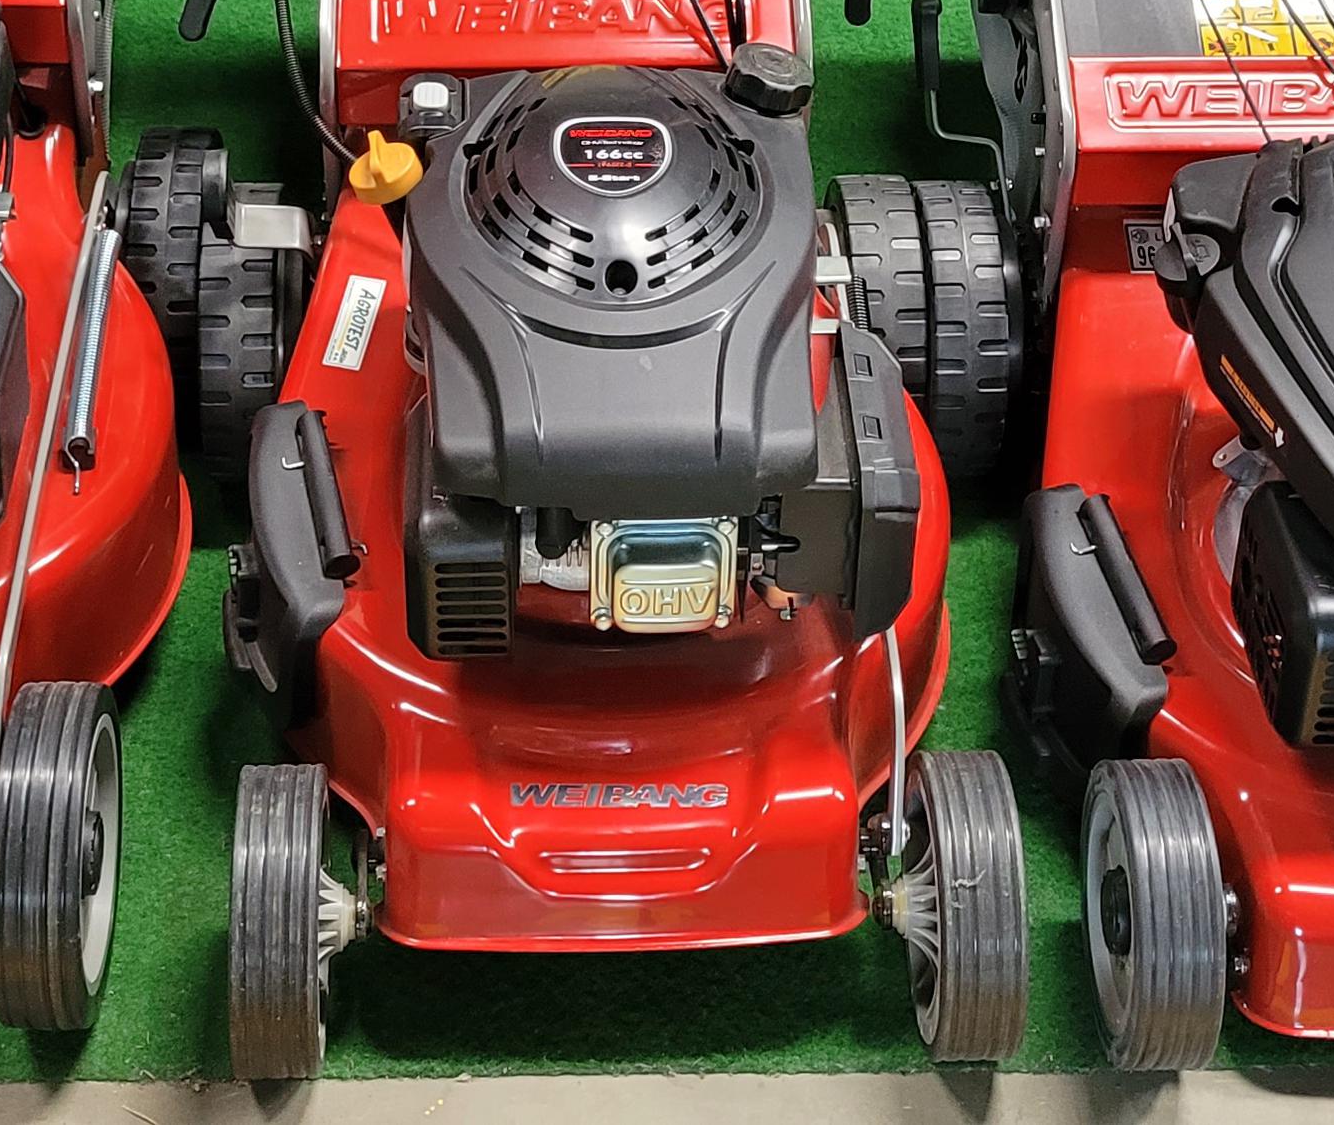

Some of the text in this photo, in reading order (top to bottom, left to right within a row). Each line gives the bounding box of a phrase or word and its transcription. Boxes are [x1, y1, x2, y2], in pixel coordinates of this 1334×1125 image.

[584, 149, 644, 160] 166cc
[345, 288, 376, 352] AGROTEST
[619, 586, 715, 616] OHV
[510, 782, 729, 809] WEIBANG
